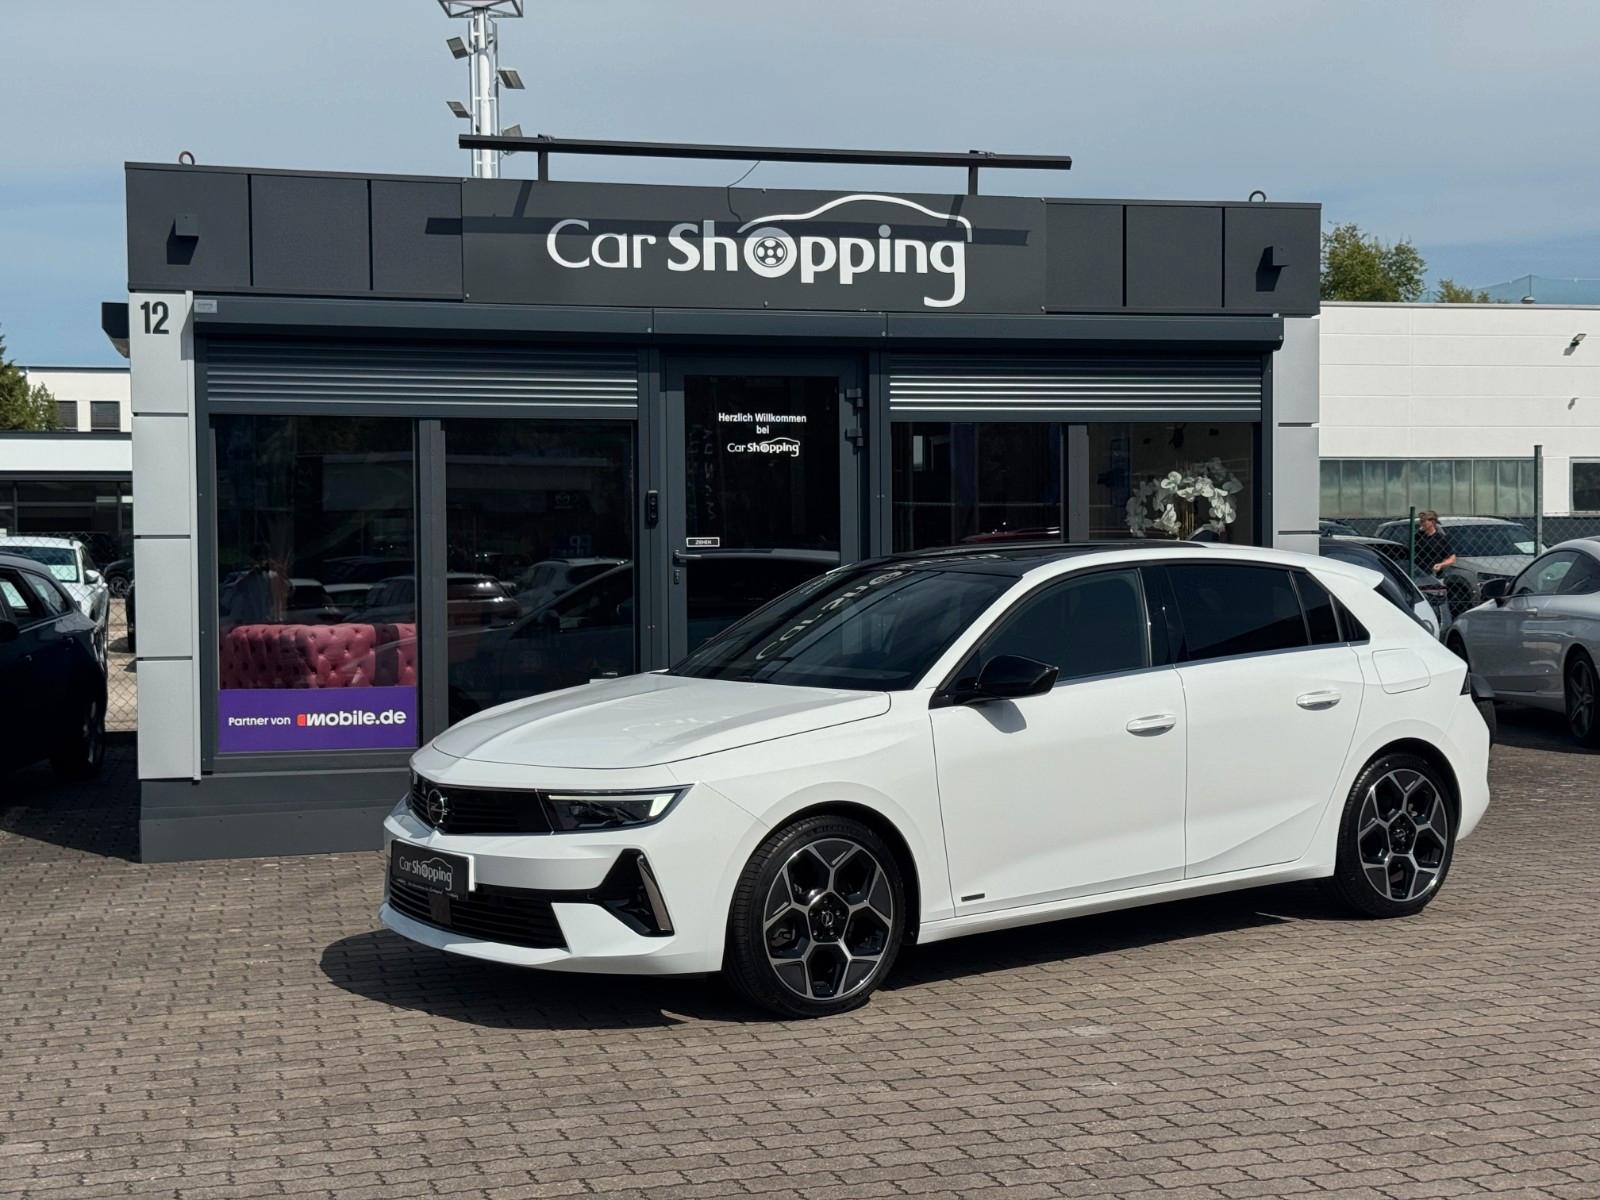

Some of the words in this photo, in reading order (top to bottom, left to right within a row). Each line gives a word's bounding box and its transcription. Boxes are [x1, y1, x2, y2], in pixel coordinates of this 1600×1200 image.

[546, 219, 656, 268] Car
[667, 219, 967, 308] Shopping
[140, 301, 169, 335] 12
[718, 412, 753, 422] Herzlich
[755, 412, 807, 423] Willkommen
[756, 425, 770, 434] bei
[727, 443, 746, 453] Car
[747, 442, 800, 457] Shopping
[228, 716, 269, 727] Partner
[270, 716, 291, 726] von
[306, 709, 407, 727] mobile.de
[399, 856, 412, 872] Car
[412, 860, 453, 891] Shopping
